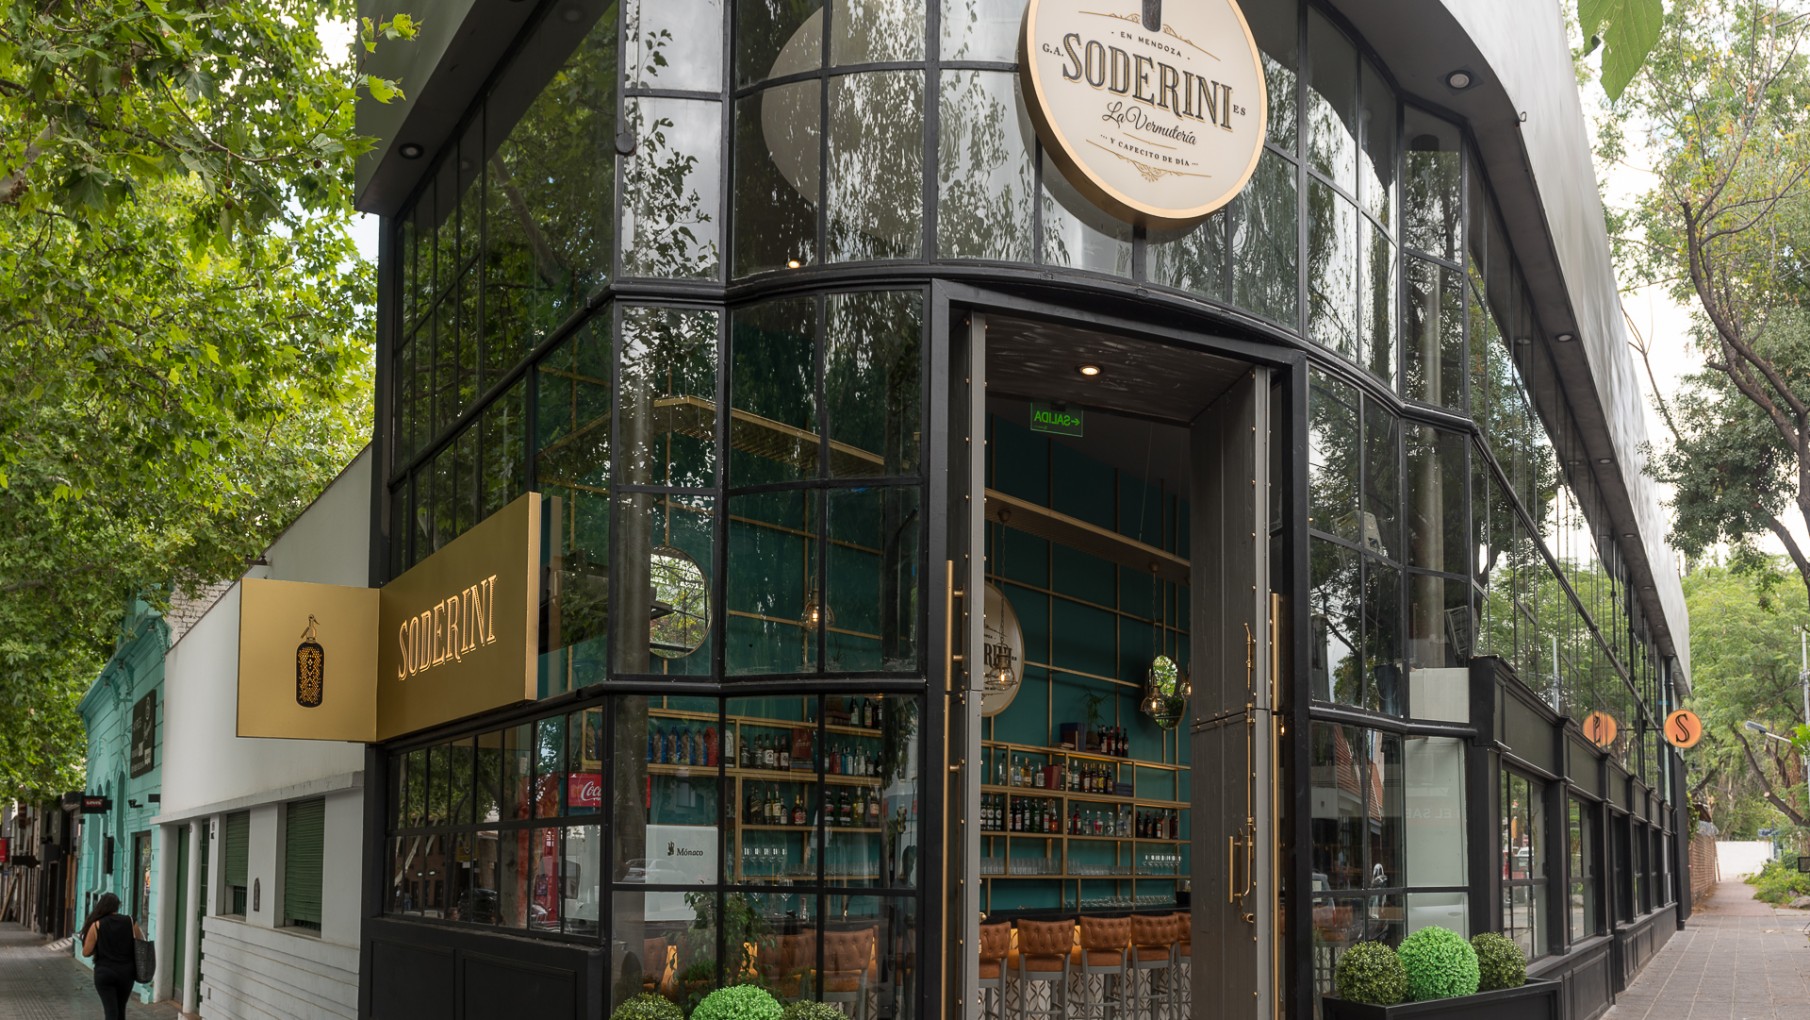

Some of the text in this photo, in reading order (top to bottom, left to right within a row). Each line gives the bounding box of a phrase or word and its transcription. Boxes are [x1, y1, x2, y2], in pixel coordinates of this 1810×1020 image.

[1120, 31, 1182, 58] EN MENDOZA
[1042, 32, 1247, 132] G.A. SODERINI ES
[1101, 101, 1197, 146] La Vermutería
[1118, 141, 1160, 160] CAFECITO
[1162, 155, 1173, 164] DE
[398, 574, 498, 681] SODERINI
[1675, 713, 1690, 743] S
[676, 847, 704, 857] Mónaco
